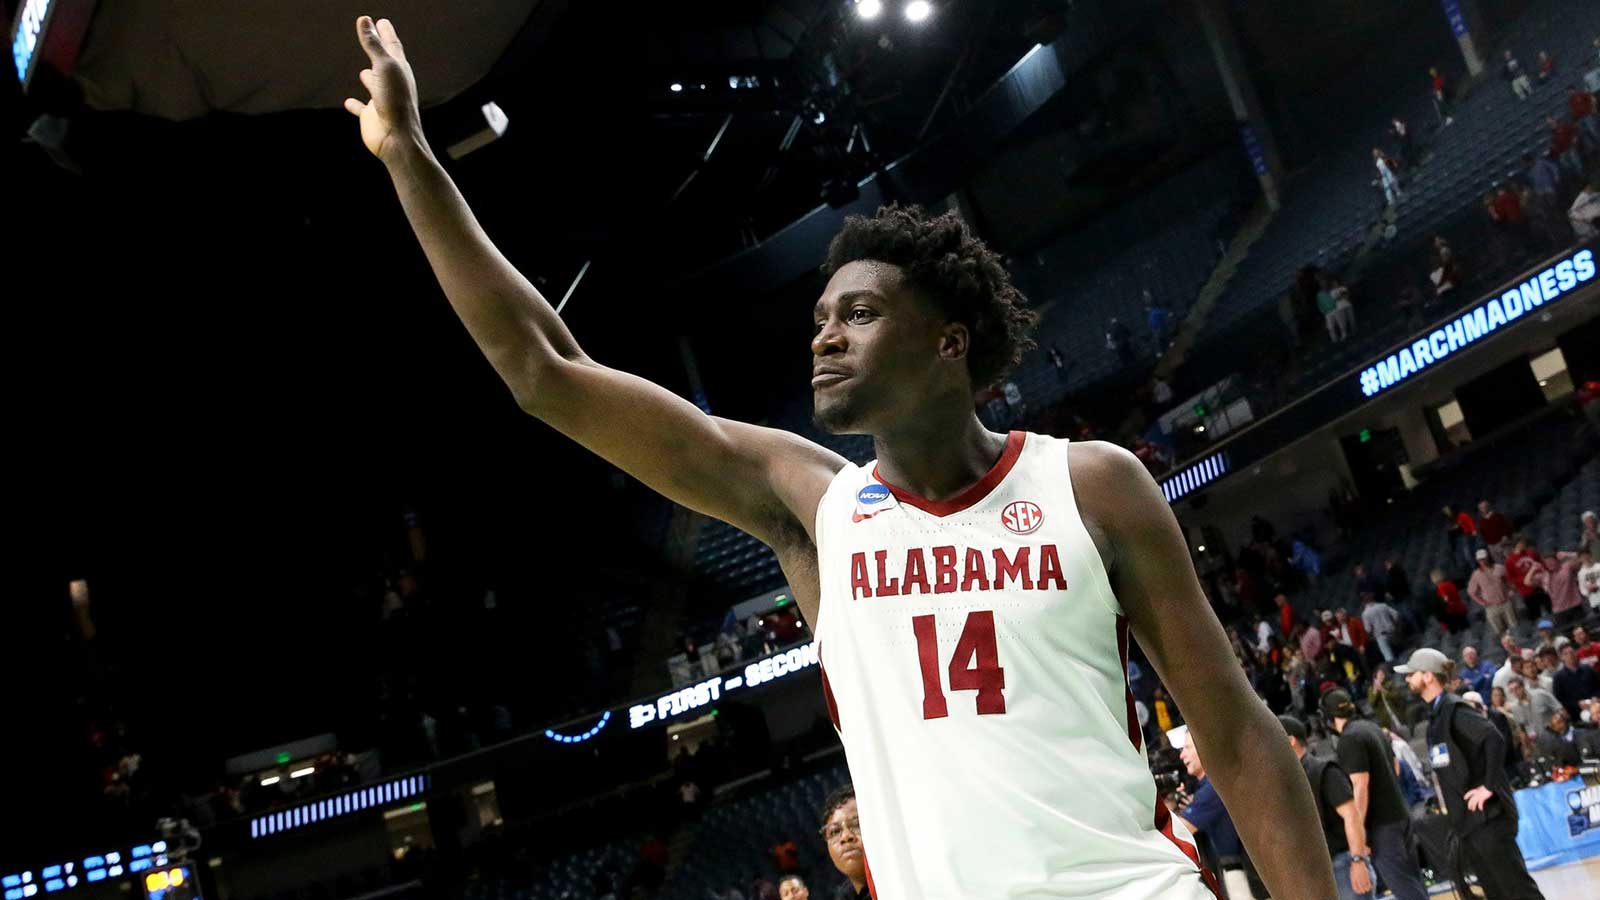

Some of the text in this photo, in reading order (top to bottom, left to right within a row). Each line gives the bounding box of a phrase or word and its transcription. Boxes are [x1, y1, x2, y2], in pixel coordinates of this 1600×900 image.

[1360, 249, 1595, 396] #MARCHMADNESS
[860, 491, 888, 500] NCAA
[1002, 501, 1041, 532] SEC
[851, 544, 1068, 600] ALABAMA
[912, 610, 1006, 720] 14
[657, 677, 722, 720] FIRST
